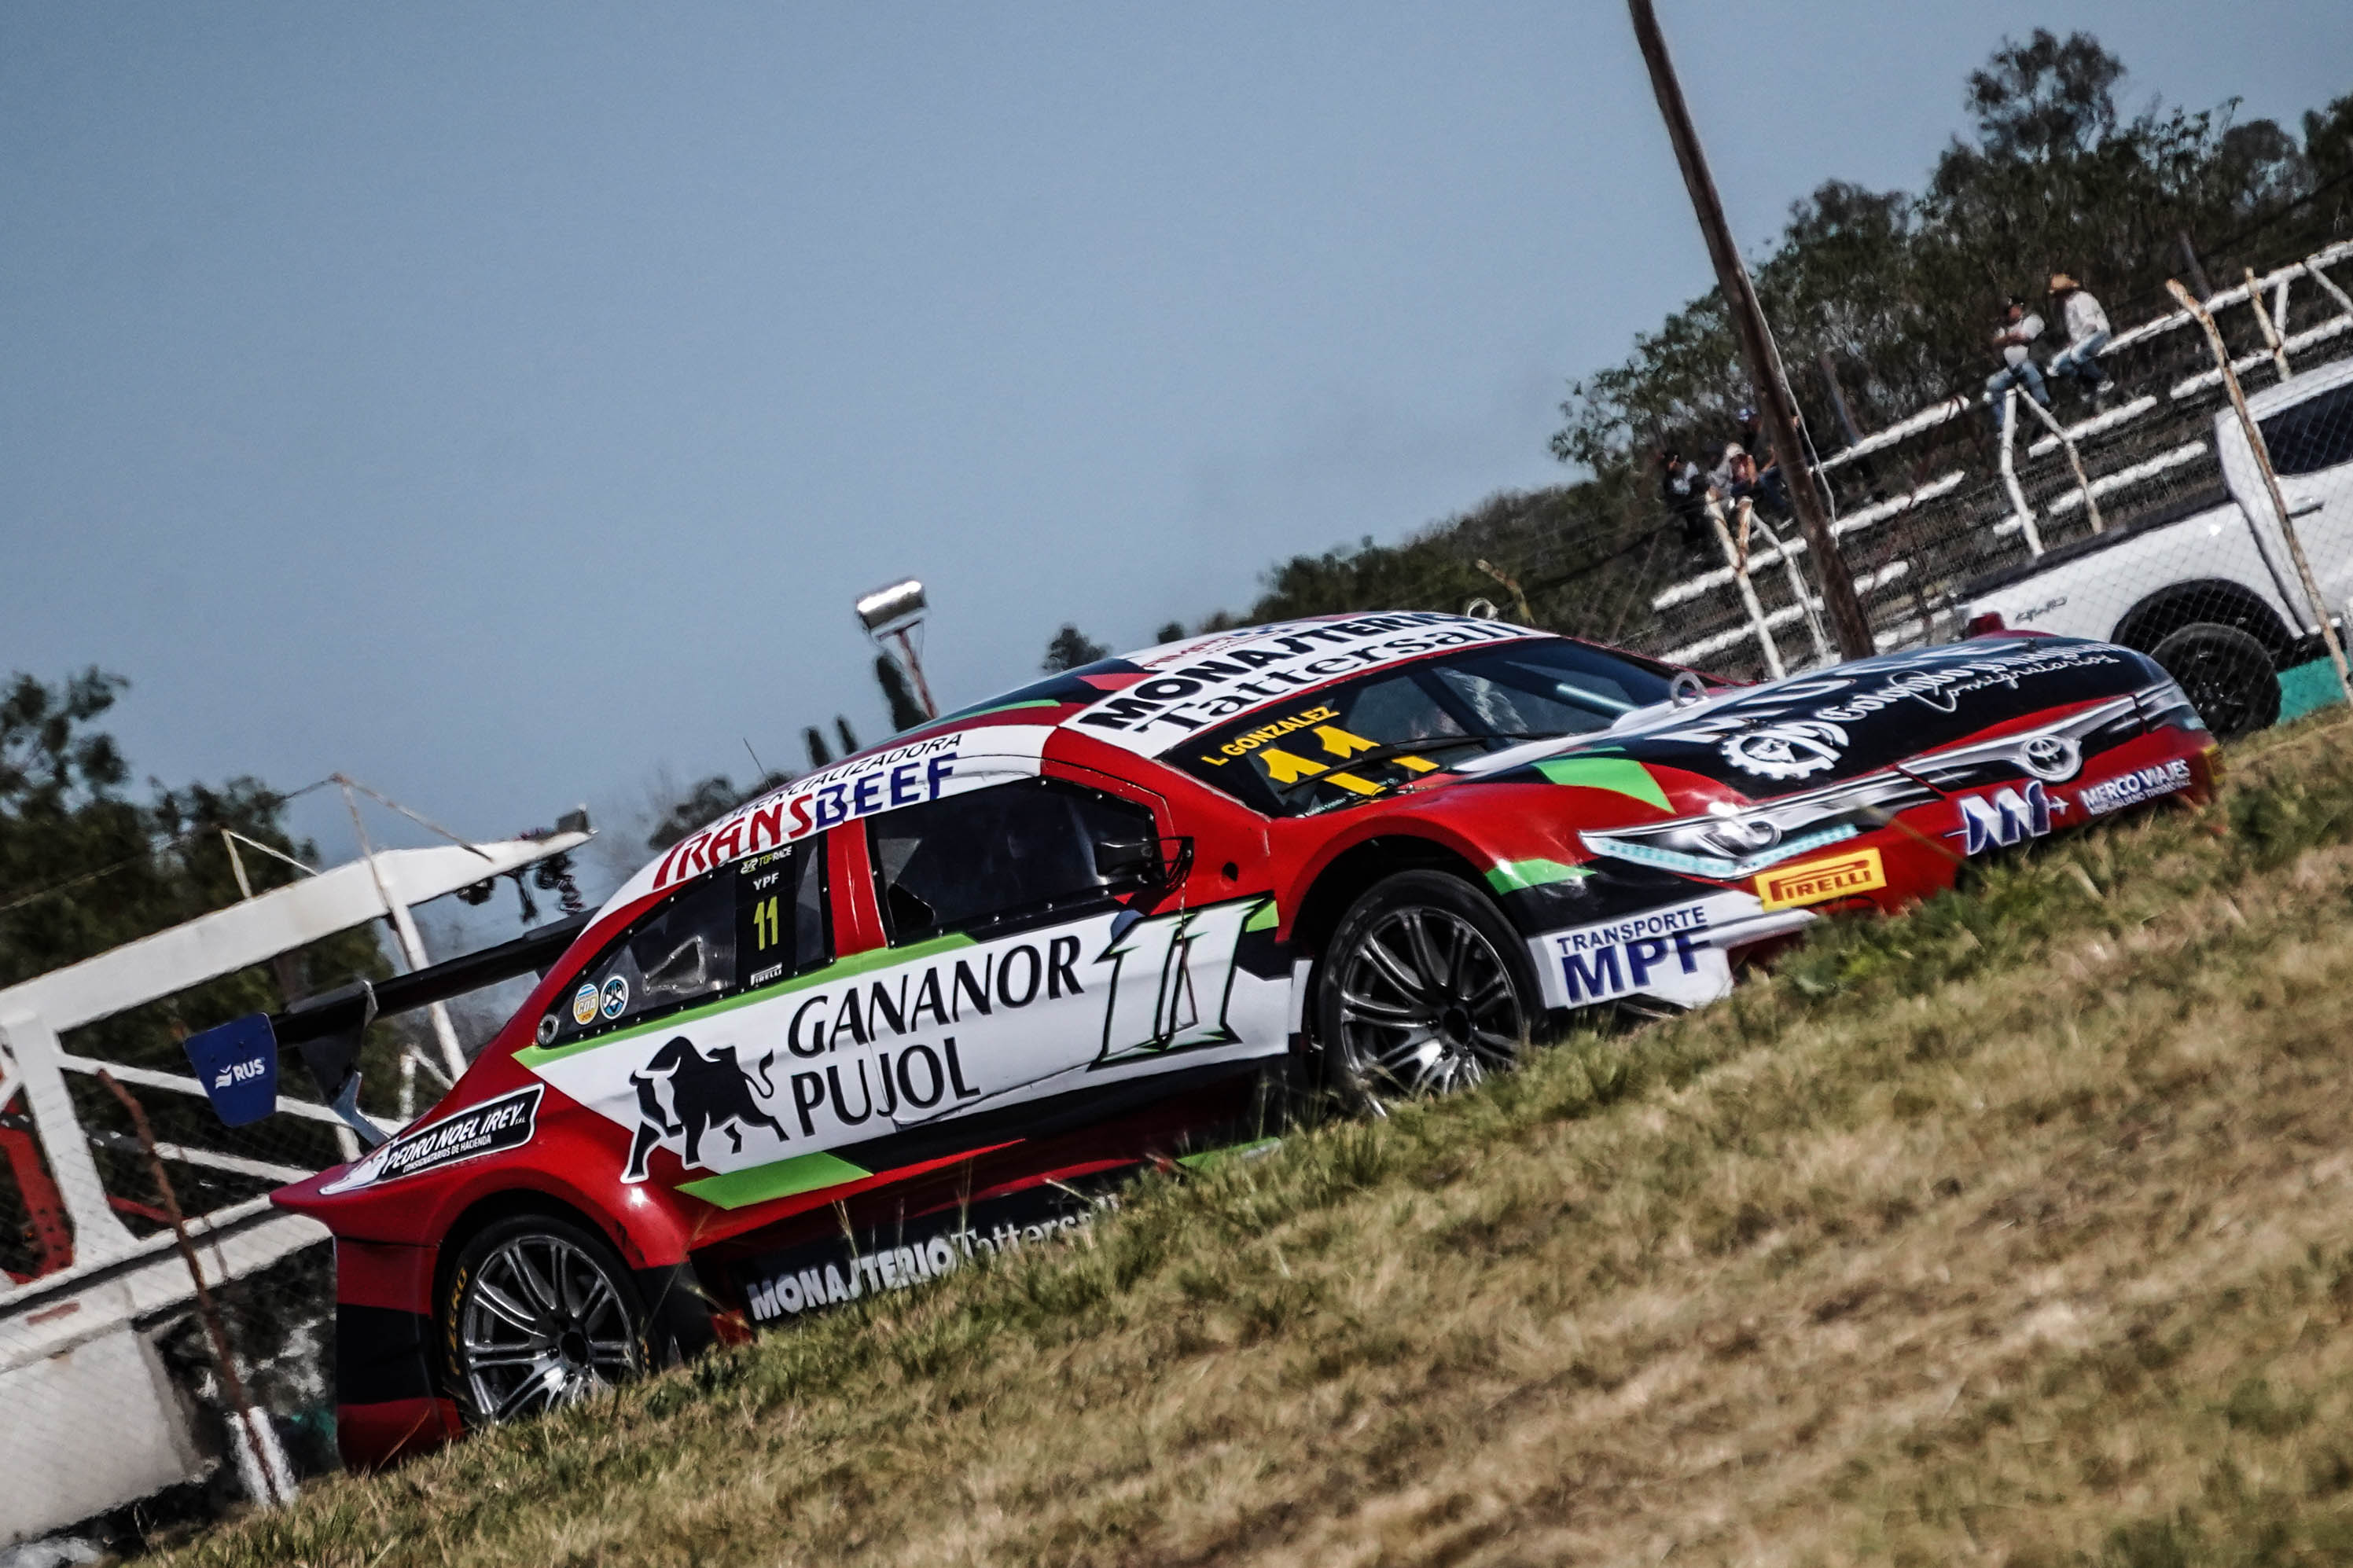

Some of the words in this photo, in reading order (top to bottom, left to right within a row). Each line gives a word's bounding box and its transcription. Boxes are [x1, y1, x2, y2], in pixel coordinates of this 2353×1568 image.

[1138, 623, 1532, 734] Tattersall
[1201, 755, 1229, 766] L
[1221, 706, 1340, 756] GONZALEZ
[2079, 773, 2142, 809] MERCO
[2138, 758, 2192, 789] VIAJES
[653, 752, 959, 890] TRANSBEEF
[753, 872, 779, 890] YPF
[1769, 859, 1873, 903] PIRELLI
[754, 896, 778, 951] 11
[1557, 905, 1708, 955] TRANSPORTE
[751, 962, 782, 986] PIRELLI
[1086, 890, 1275, 1072] 11
[1562, 924, 1711, 1003] MPF
[787, 935, 1086, 1059] GANANOR
[233, 1058, 265, 1082] RUS
[792, 1035, 982, 1138] PUJOL
[382, 1132, 438, 1174] PEDRO
[435, 1116, 480, 1151] NOEL
[480, 1102, 526, 1135] IREY
[450, 1142, 460, 1155] DE
[459, 1134, 493, 1154] HACIENDA
